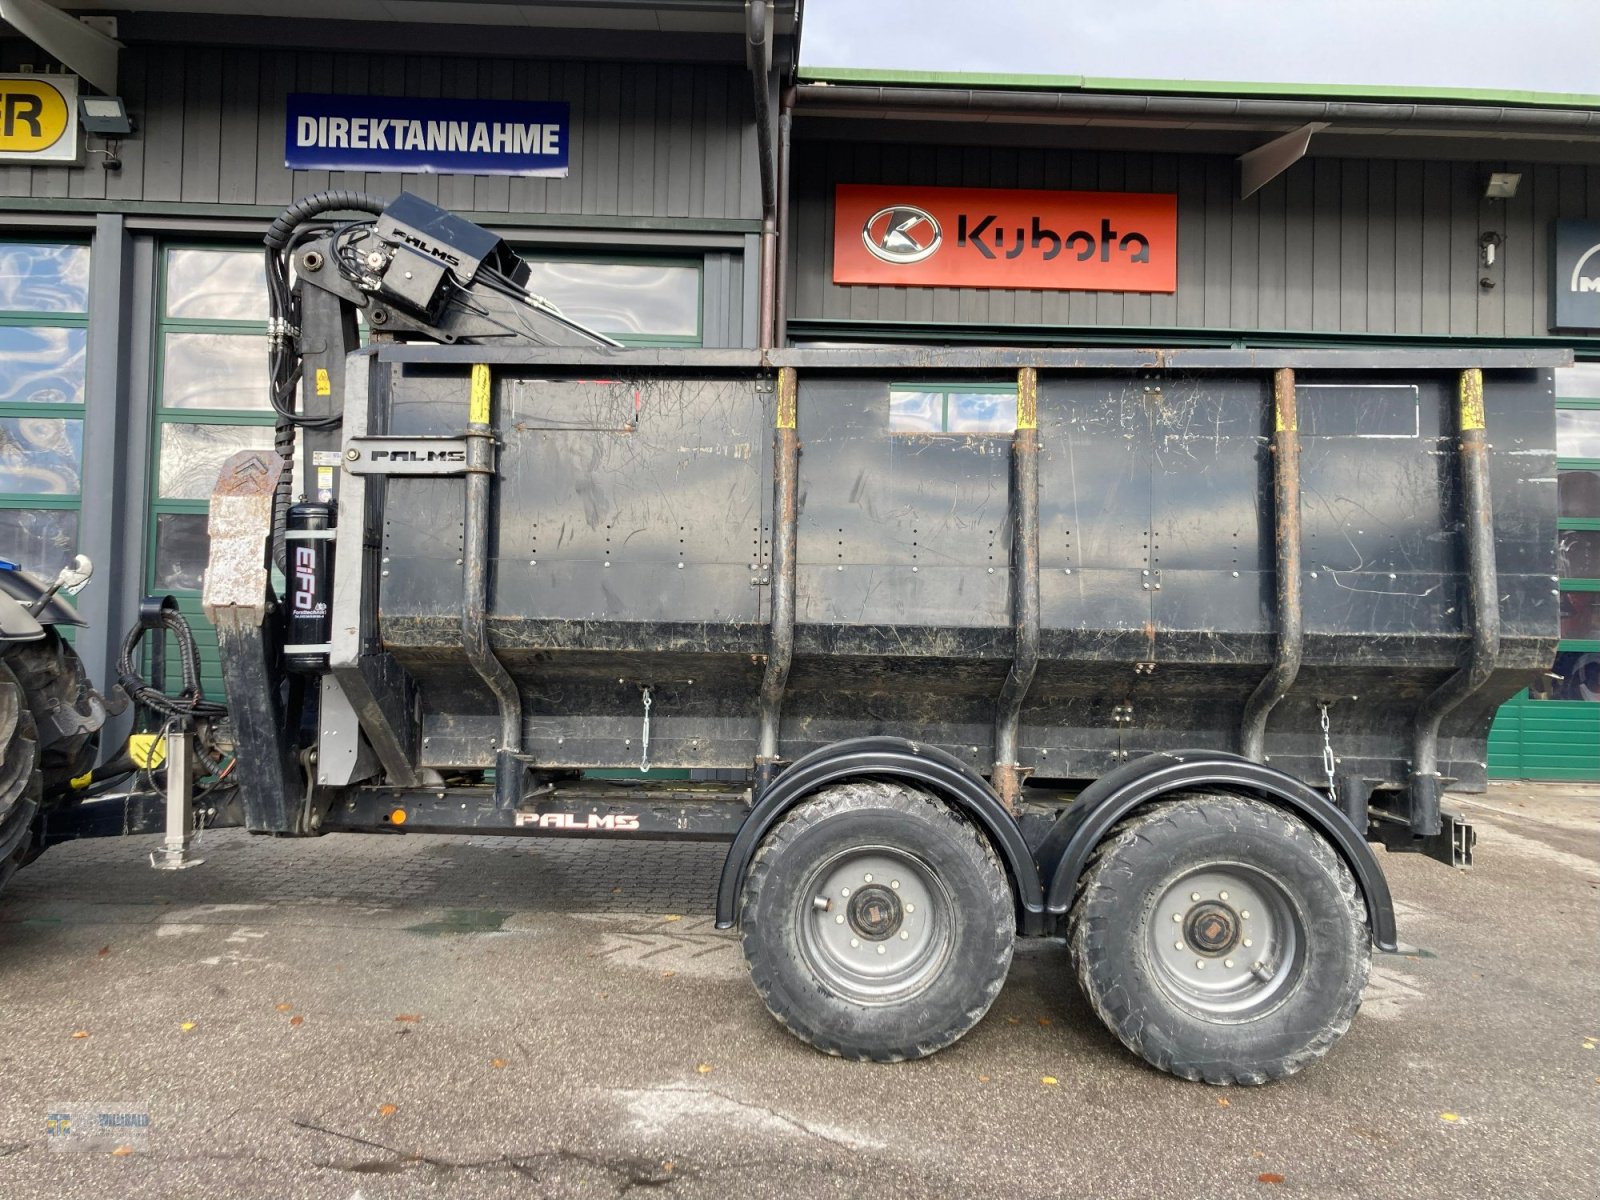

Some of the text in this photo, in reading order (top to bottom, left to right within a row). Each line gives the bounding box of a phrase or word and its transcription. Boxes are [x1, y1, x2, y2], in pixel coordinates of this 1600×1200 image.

[296, 115, 560, 155] DIREKTANNAHME
[391, 227, 460, 267] PALMS
[957, 213, 1150, 264] Kubota
[371, 450, 466, 462] PALMS
[514, 812, 641, 830] PALMS
